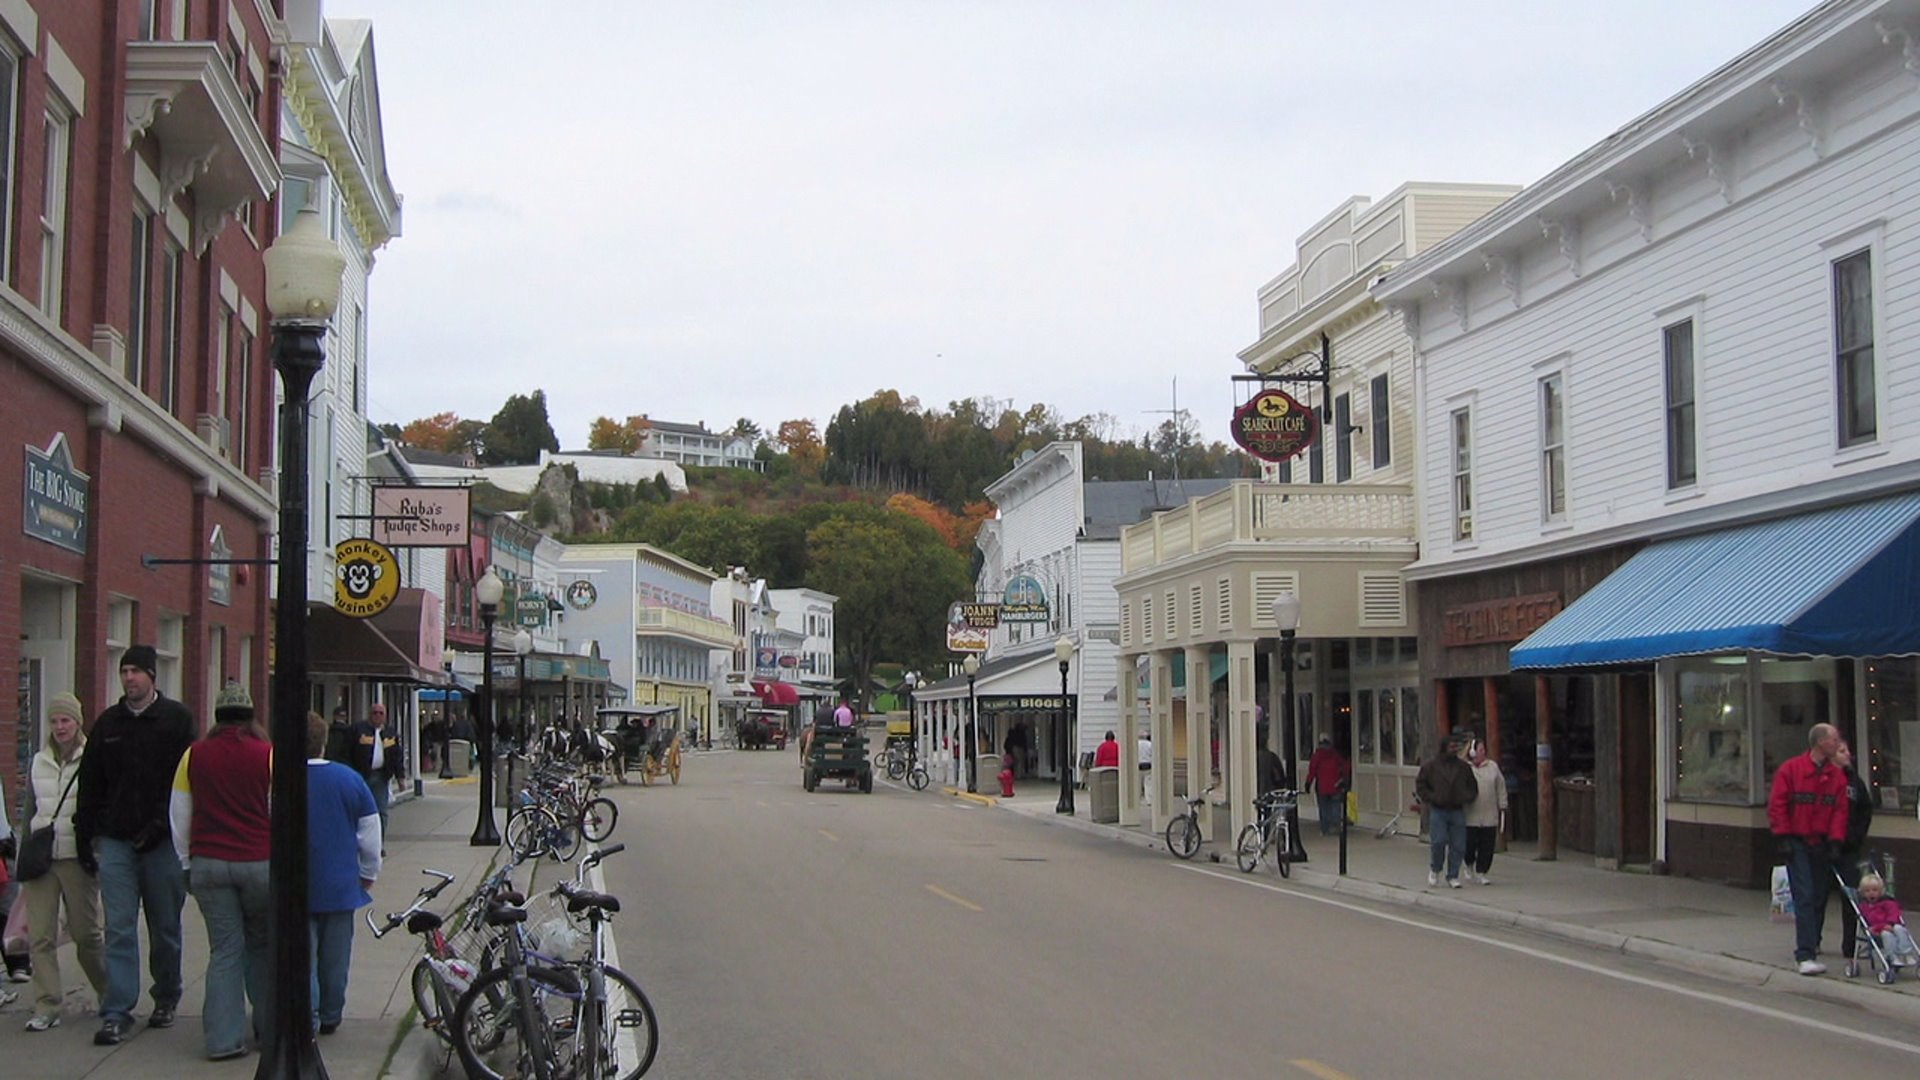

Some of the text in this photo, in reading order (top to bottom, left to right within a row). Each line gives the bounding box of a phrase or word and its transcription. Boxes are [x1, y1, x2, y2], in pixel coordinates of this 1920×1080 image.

[46, 469, 62, 502] BIG
[63, 480, 84, 513] STORE
[400, 498, 442, 517] Ryba's
[420, 518, 460, 536] Shops
[969, 617, 995, 626] FUDGE
